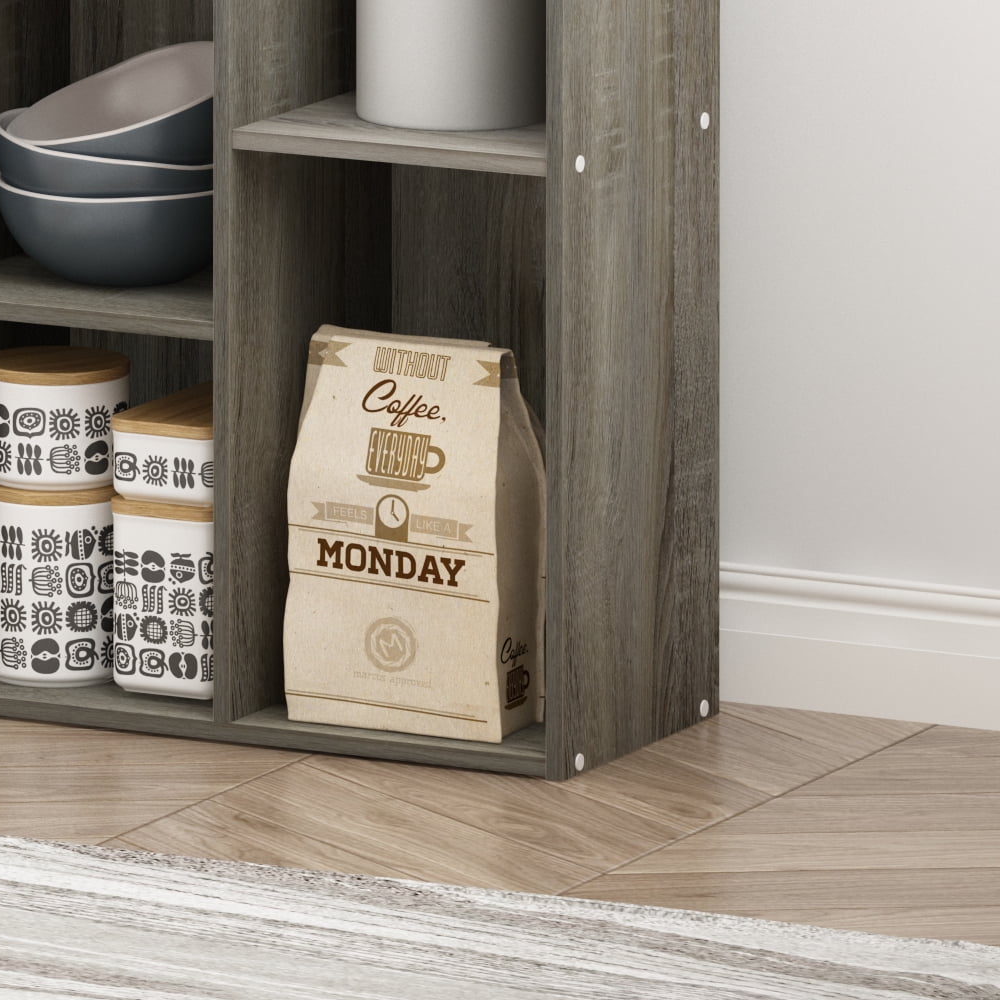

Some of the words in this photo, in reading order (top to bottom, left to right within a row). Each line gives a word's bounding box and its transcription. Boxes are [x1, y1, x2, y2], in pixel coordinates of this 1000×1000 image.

[373, 346, 452, 381] WITHOUT
[367, 429, 430, 479] EVERYDAY
[332, 506, 368, 520] FEELS
[416, 520, 440, 532] LIKE
[443, 523, 451, 533] A
[316, 538, 466, 587] MONDAY
